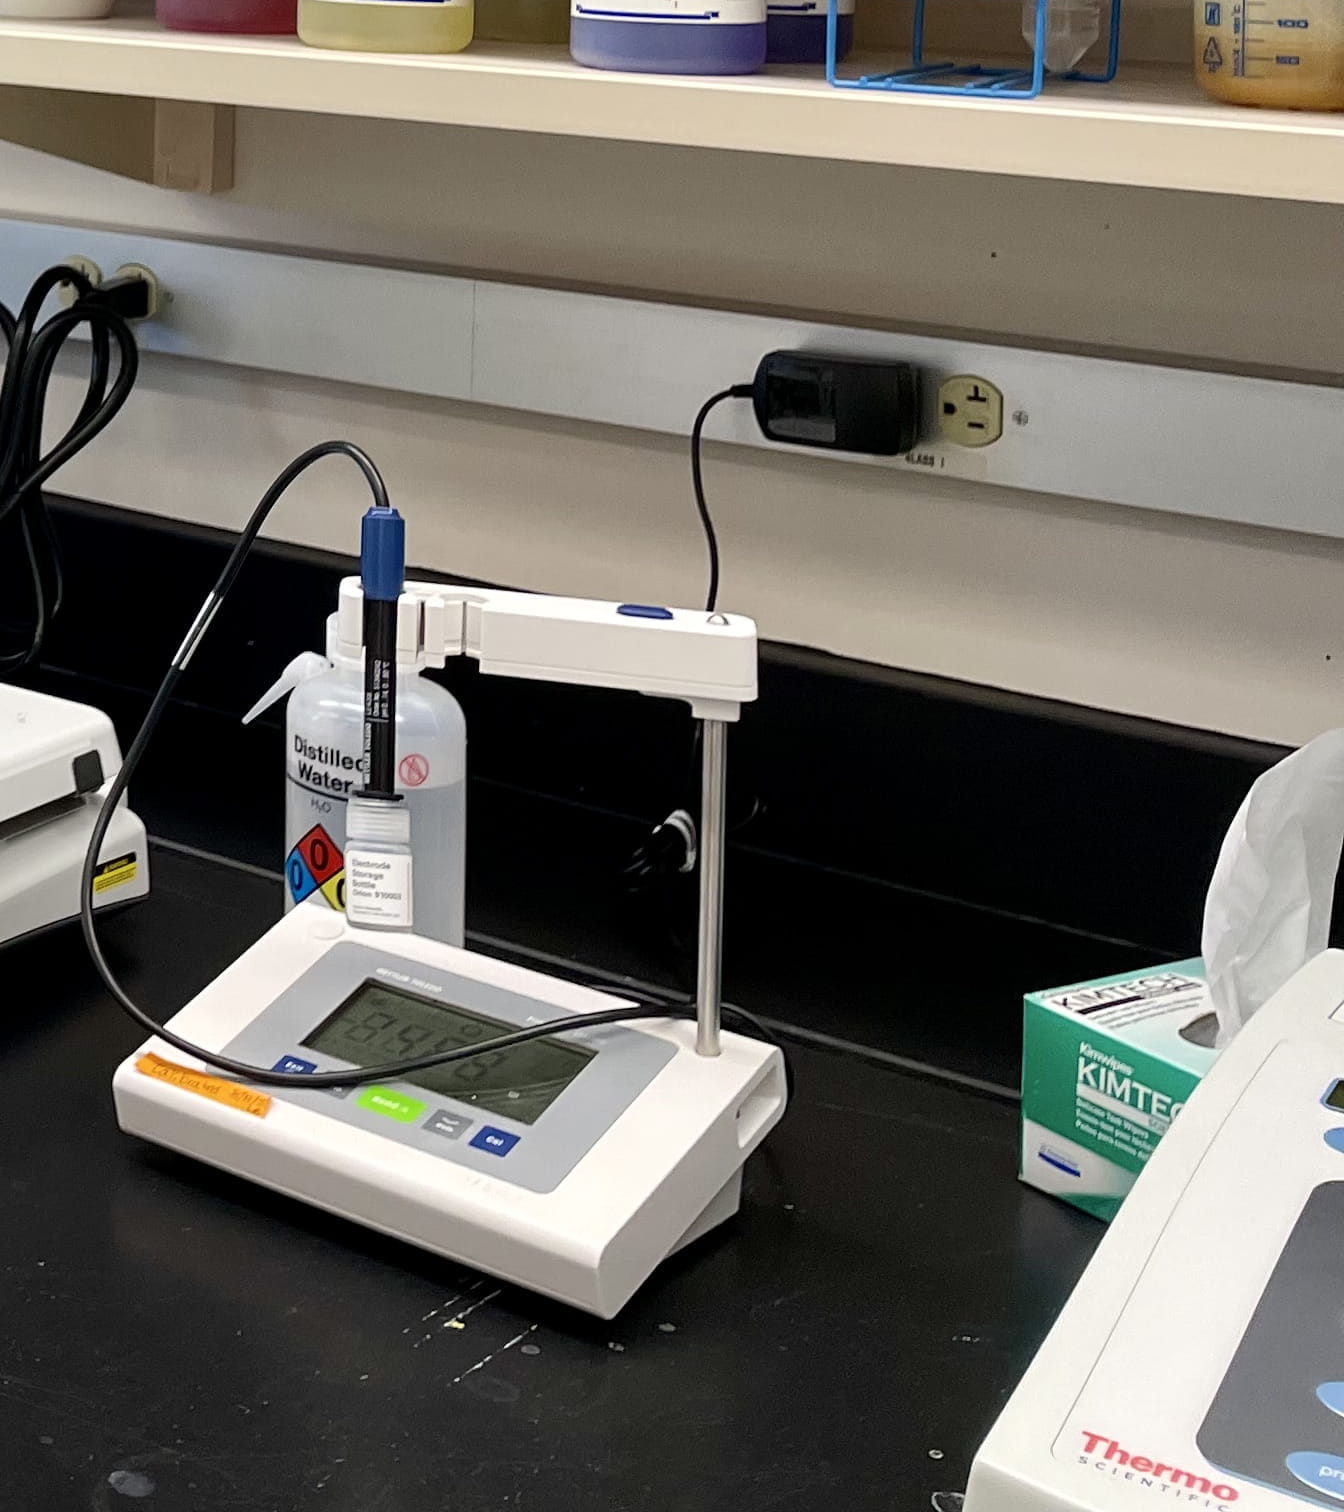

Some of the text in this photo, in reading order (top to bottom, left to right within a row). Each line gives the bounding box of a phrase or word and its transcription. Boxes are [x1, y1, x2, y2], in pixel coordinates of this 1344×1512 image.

[1277, 19, 1309, 28] 100
[298, 759, 354, 793] Water
[310, 838, 329, 871] 0
[291, 859, 303, 891] 0
[1079, 1041, 1134, 1076] Kimwipes
[1078, 1056, 1186, 1125] KIMTEC
[1082, 1430, 1240, 1502] Thermo
[1079, 1455, 1234, 1512] SCIENTIFIC
